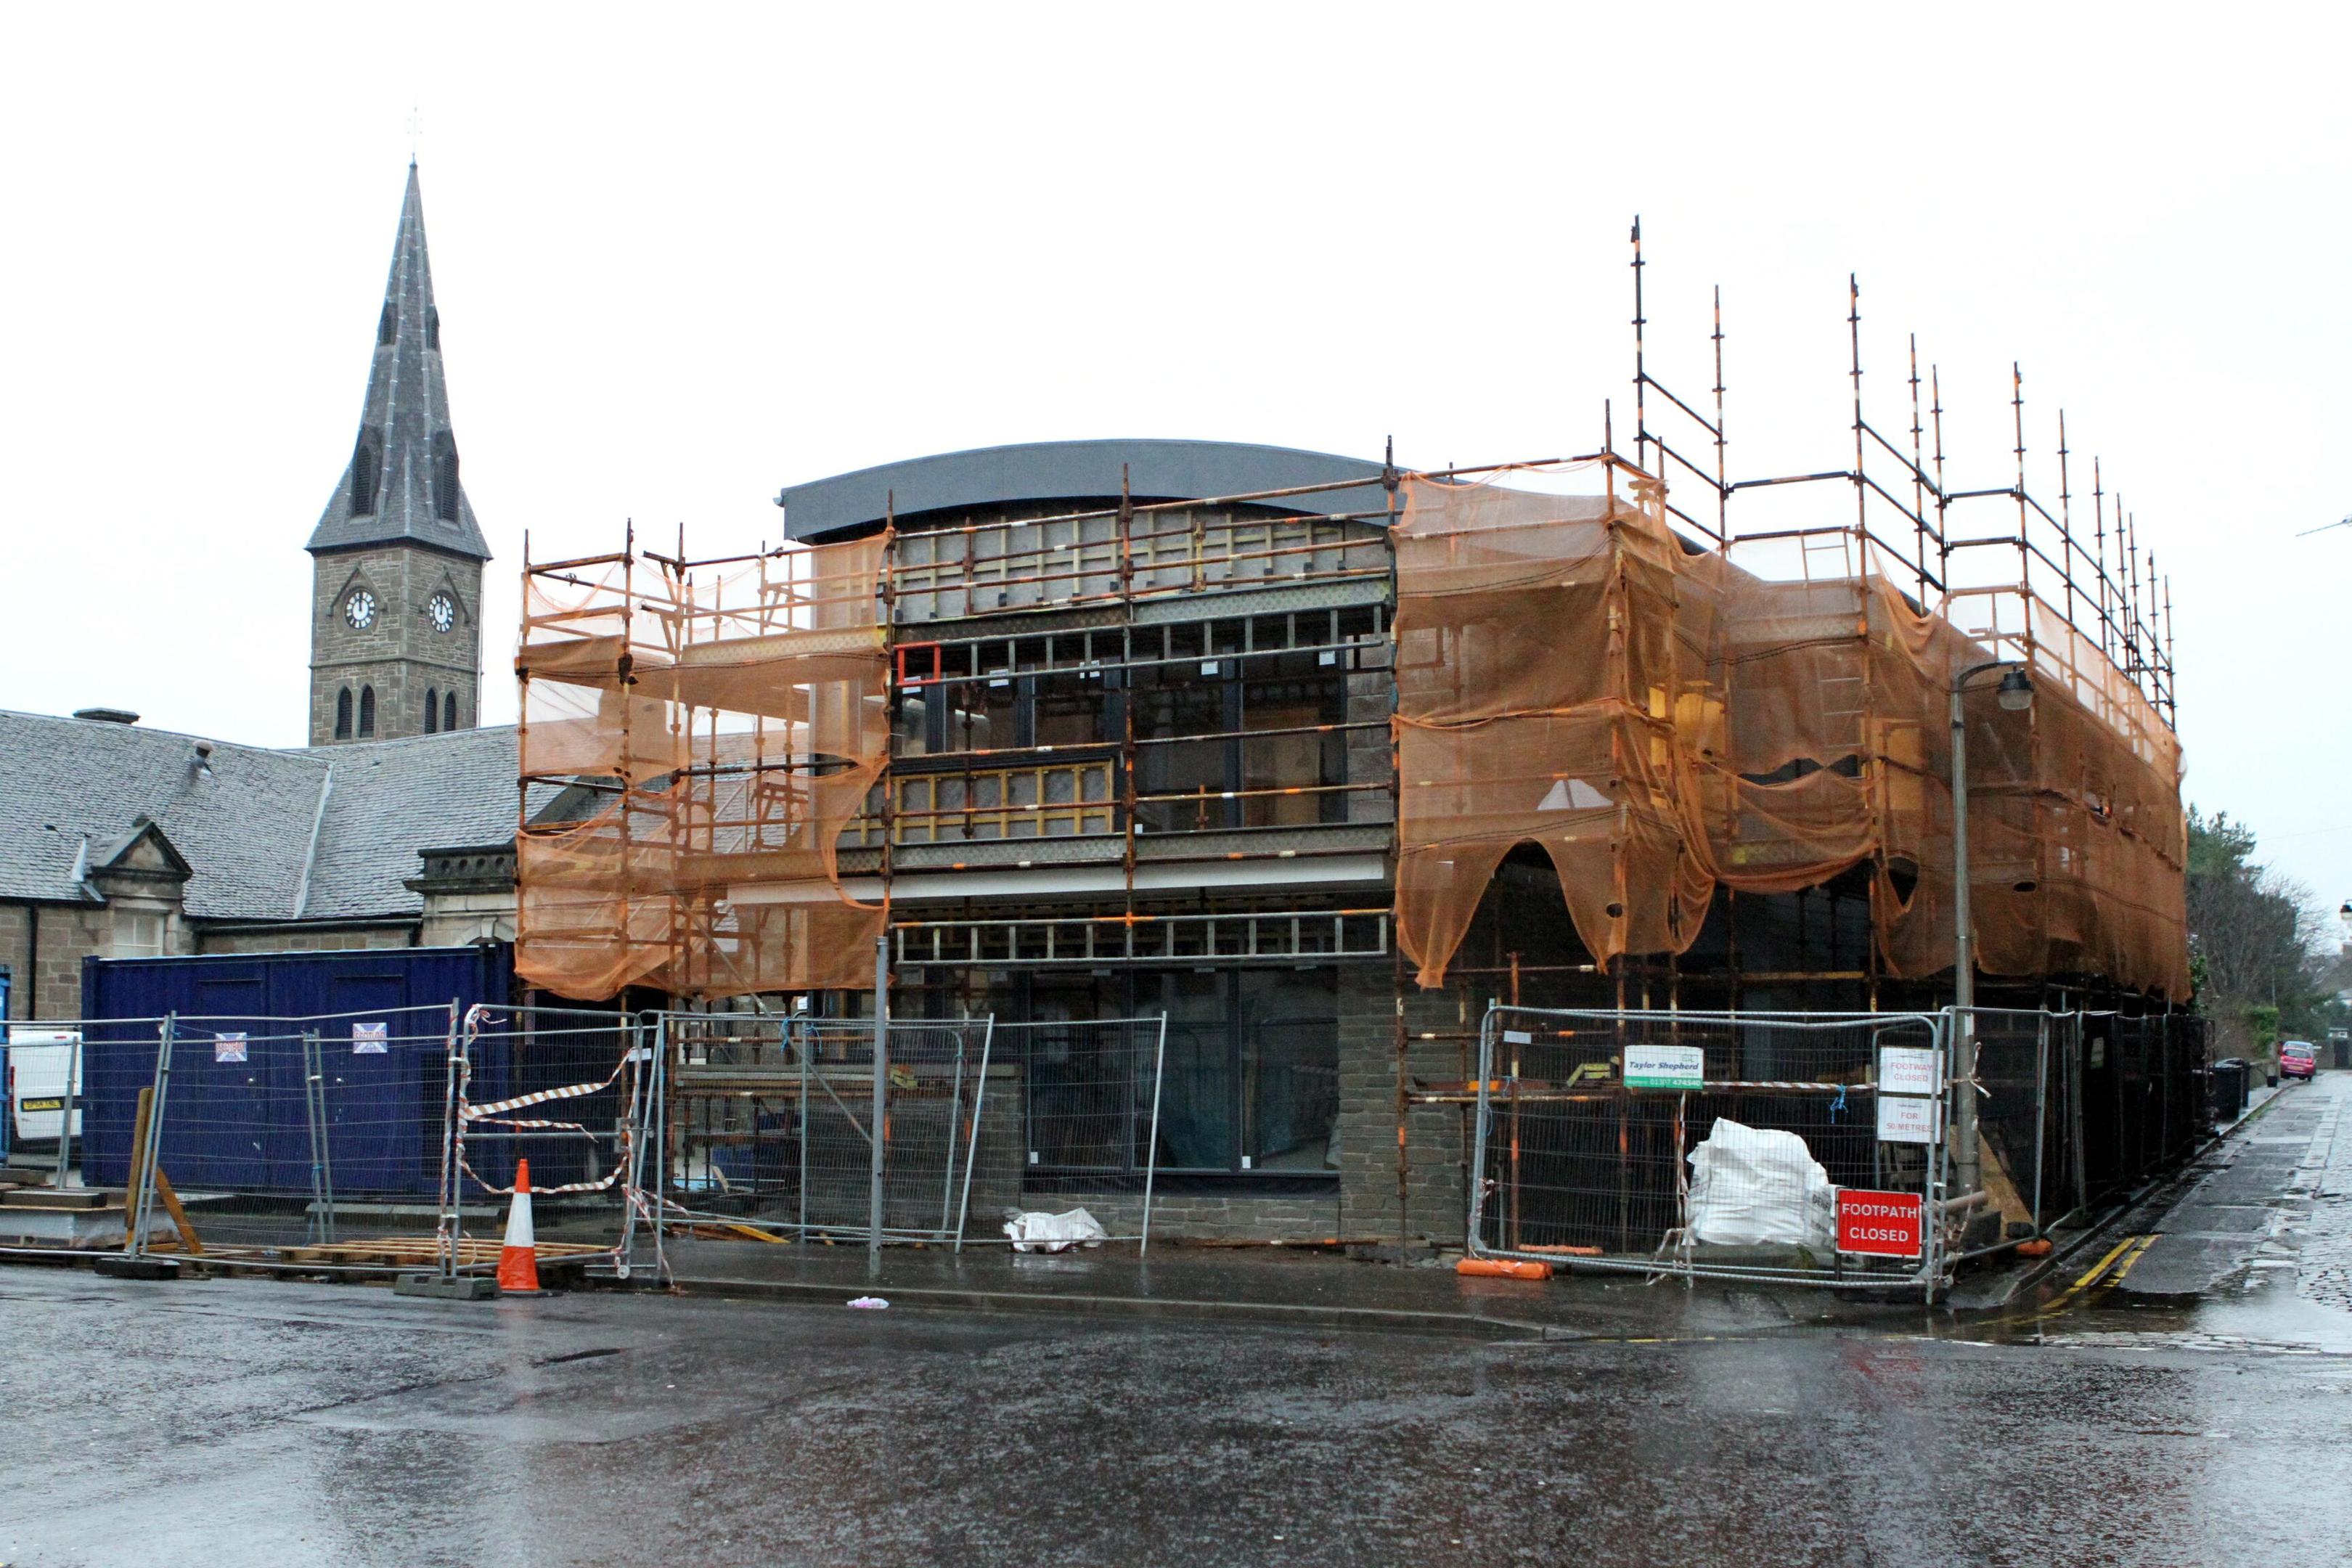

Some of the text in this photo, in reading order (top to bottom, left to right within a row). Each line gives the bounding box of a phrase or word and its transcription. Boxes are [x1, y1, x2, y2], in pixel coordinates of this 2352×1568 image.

[1630, 1061, 1699, 1071] Taylor Shepherd
[1891, 1062, 1934, 1071] FOOTWAY
[1894, 1073, 1928, 1082] CLOSED
[1898, 1123, 1934, 1132] METRES
[1842, 1203, 1916, 1218] FOOTPATH
[1850, 1227, 1908, 1242] CLOSED
